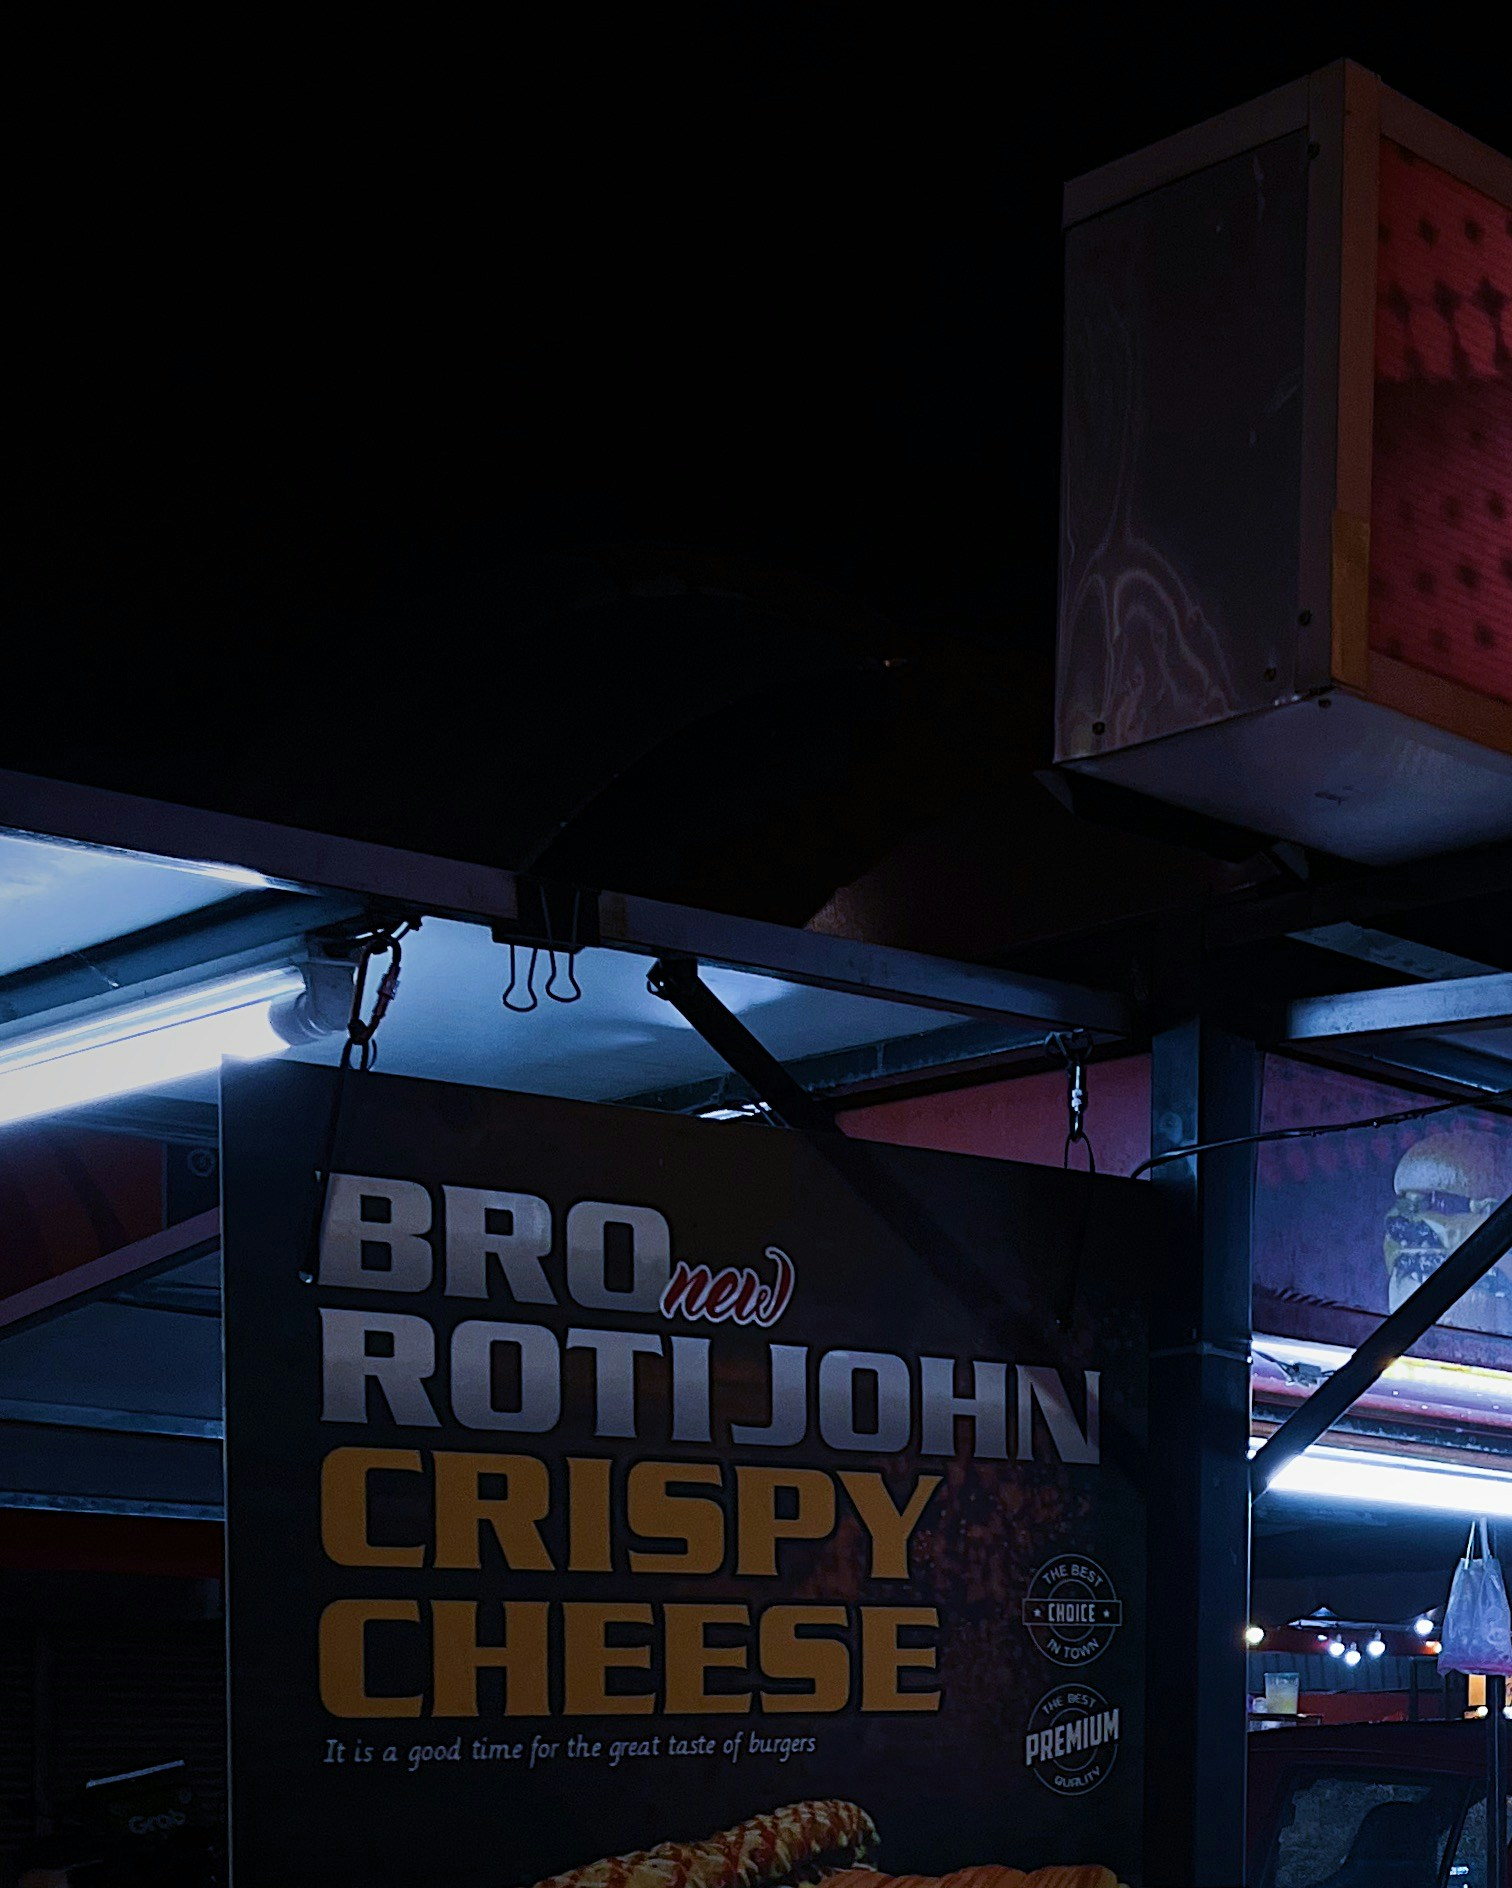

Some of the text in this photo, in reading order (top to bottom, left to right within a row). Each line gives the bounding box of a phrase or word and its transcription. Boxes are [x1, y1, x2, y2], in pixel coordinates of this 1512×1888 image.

[317, 1172, 671, 1314] BRO
[660, 1247, 796, 1327] new
[317, 1307, 1101, 1465] ROTI JOHN
[320, 1446, 944, 1580] CRISPY
[1042, 1563, 1104, 1588] THE BEST
[1048, 1602, 1096, 1623] CHOICE
[319, 1600, 944, 1719] CHEESE
[1047, 1638, 1099, 1660] IN TOWN
[1042, 1692, 1097, 1716] THE BEST
[322, 1731, 817, 1772] It is a good time for the great taste of burgers
[1025, 1708, 1120, 1766] PREMIUM
[1054, 1765, 1101, 1788] QUALITY
